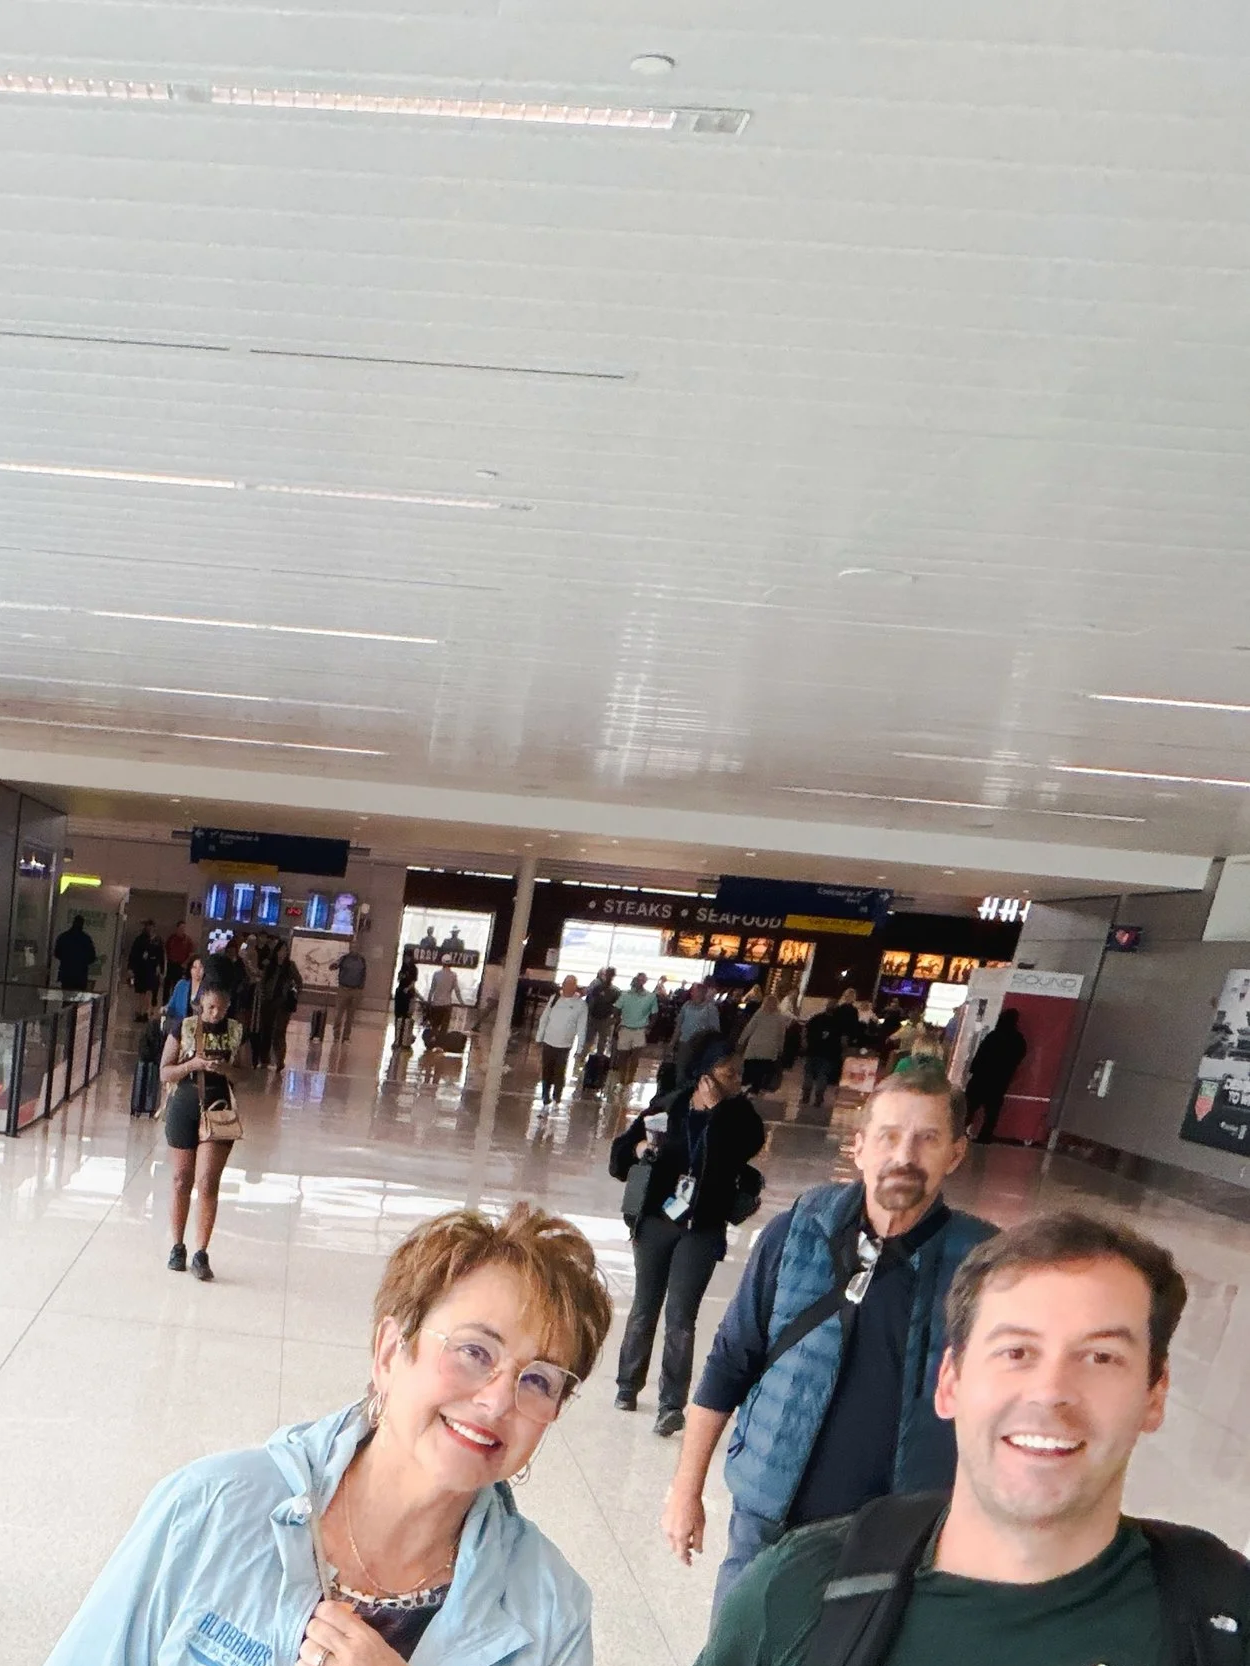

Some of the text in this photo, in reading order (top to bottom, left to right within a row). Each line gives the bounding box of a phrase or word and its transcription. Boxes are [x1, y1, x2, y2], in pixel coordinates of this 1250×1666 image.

[602, 898, 673, 919] STEAKS
[695, 906, 782, 929] SEAFOOD
[1011, 973, 1077, 988] SOUND
